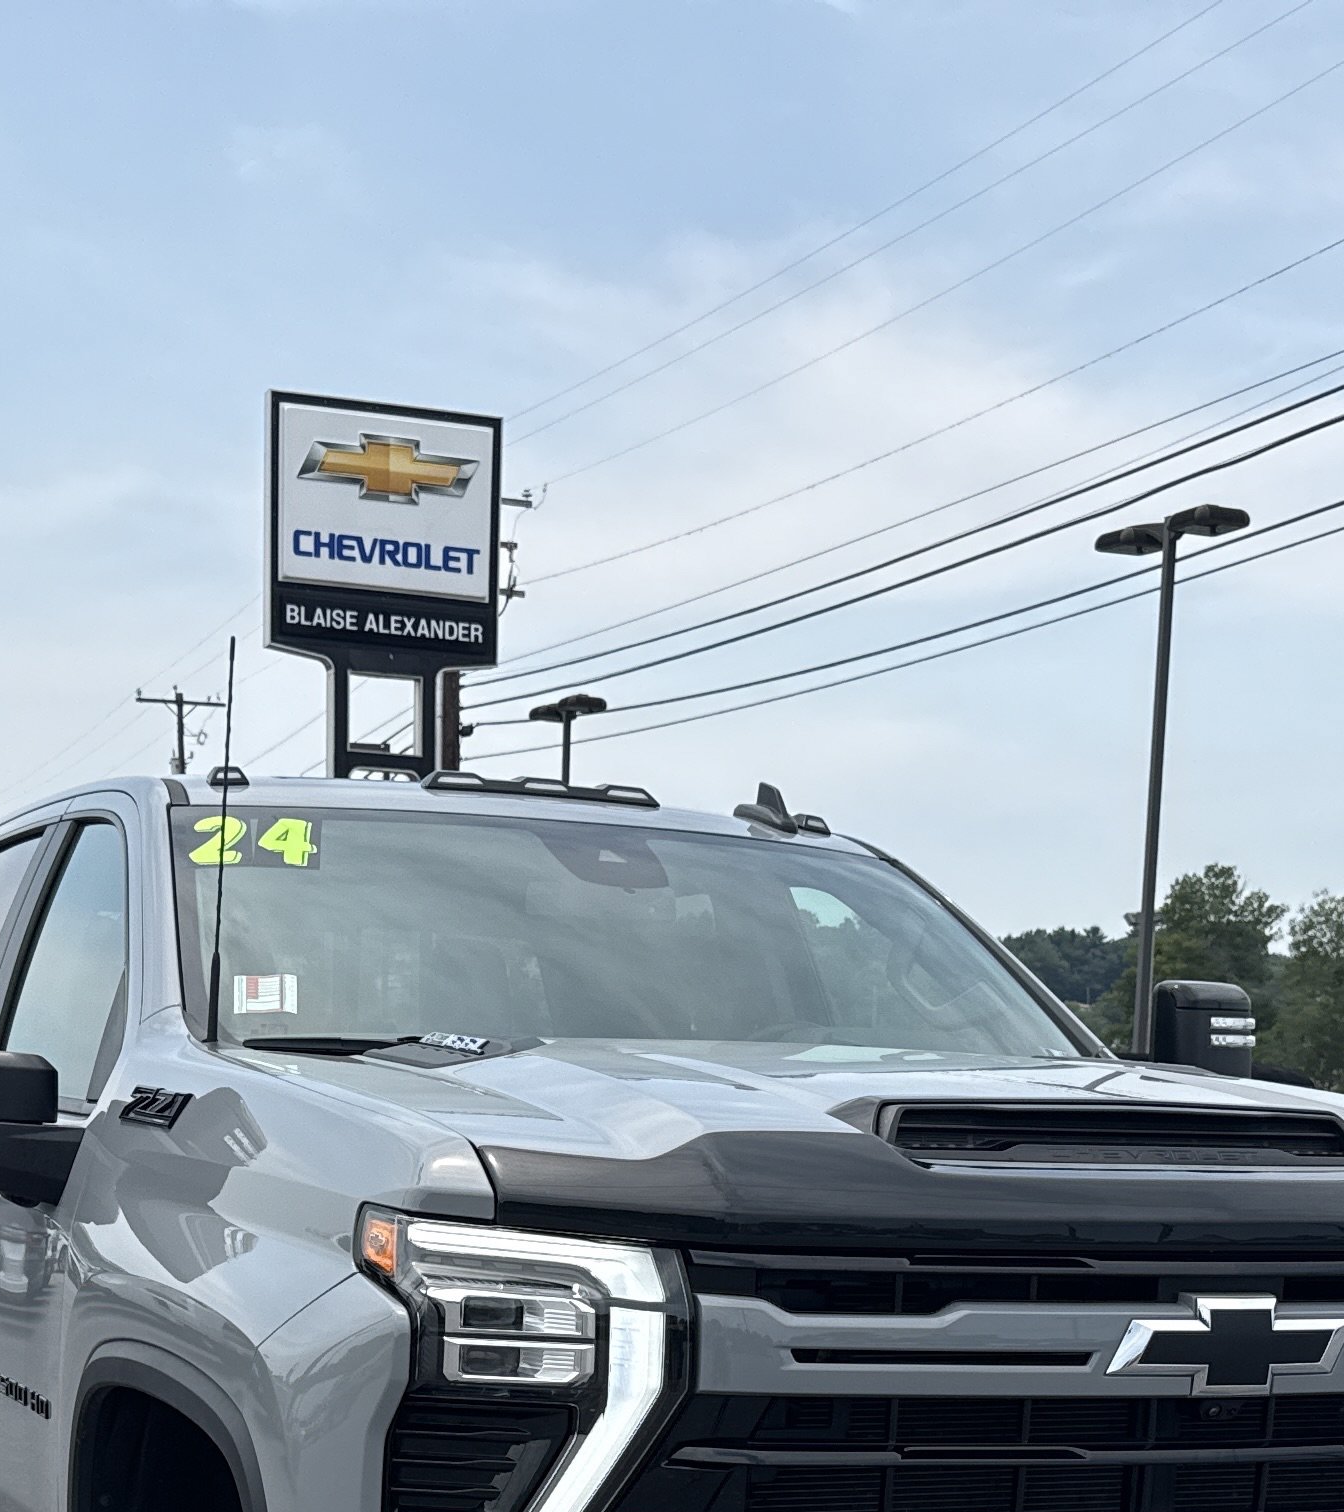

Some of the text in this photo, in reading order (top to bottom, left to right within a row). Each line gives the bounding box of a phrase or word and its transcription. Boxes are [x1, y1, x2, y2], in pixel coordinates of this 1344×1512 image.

[292, 529, 480, 575] CHEVROLET
[285, 603, 484, 644] BLAISE ALEXANDER
[188, 815, 318, 867] 24
